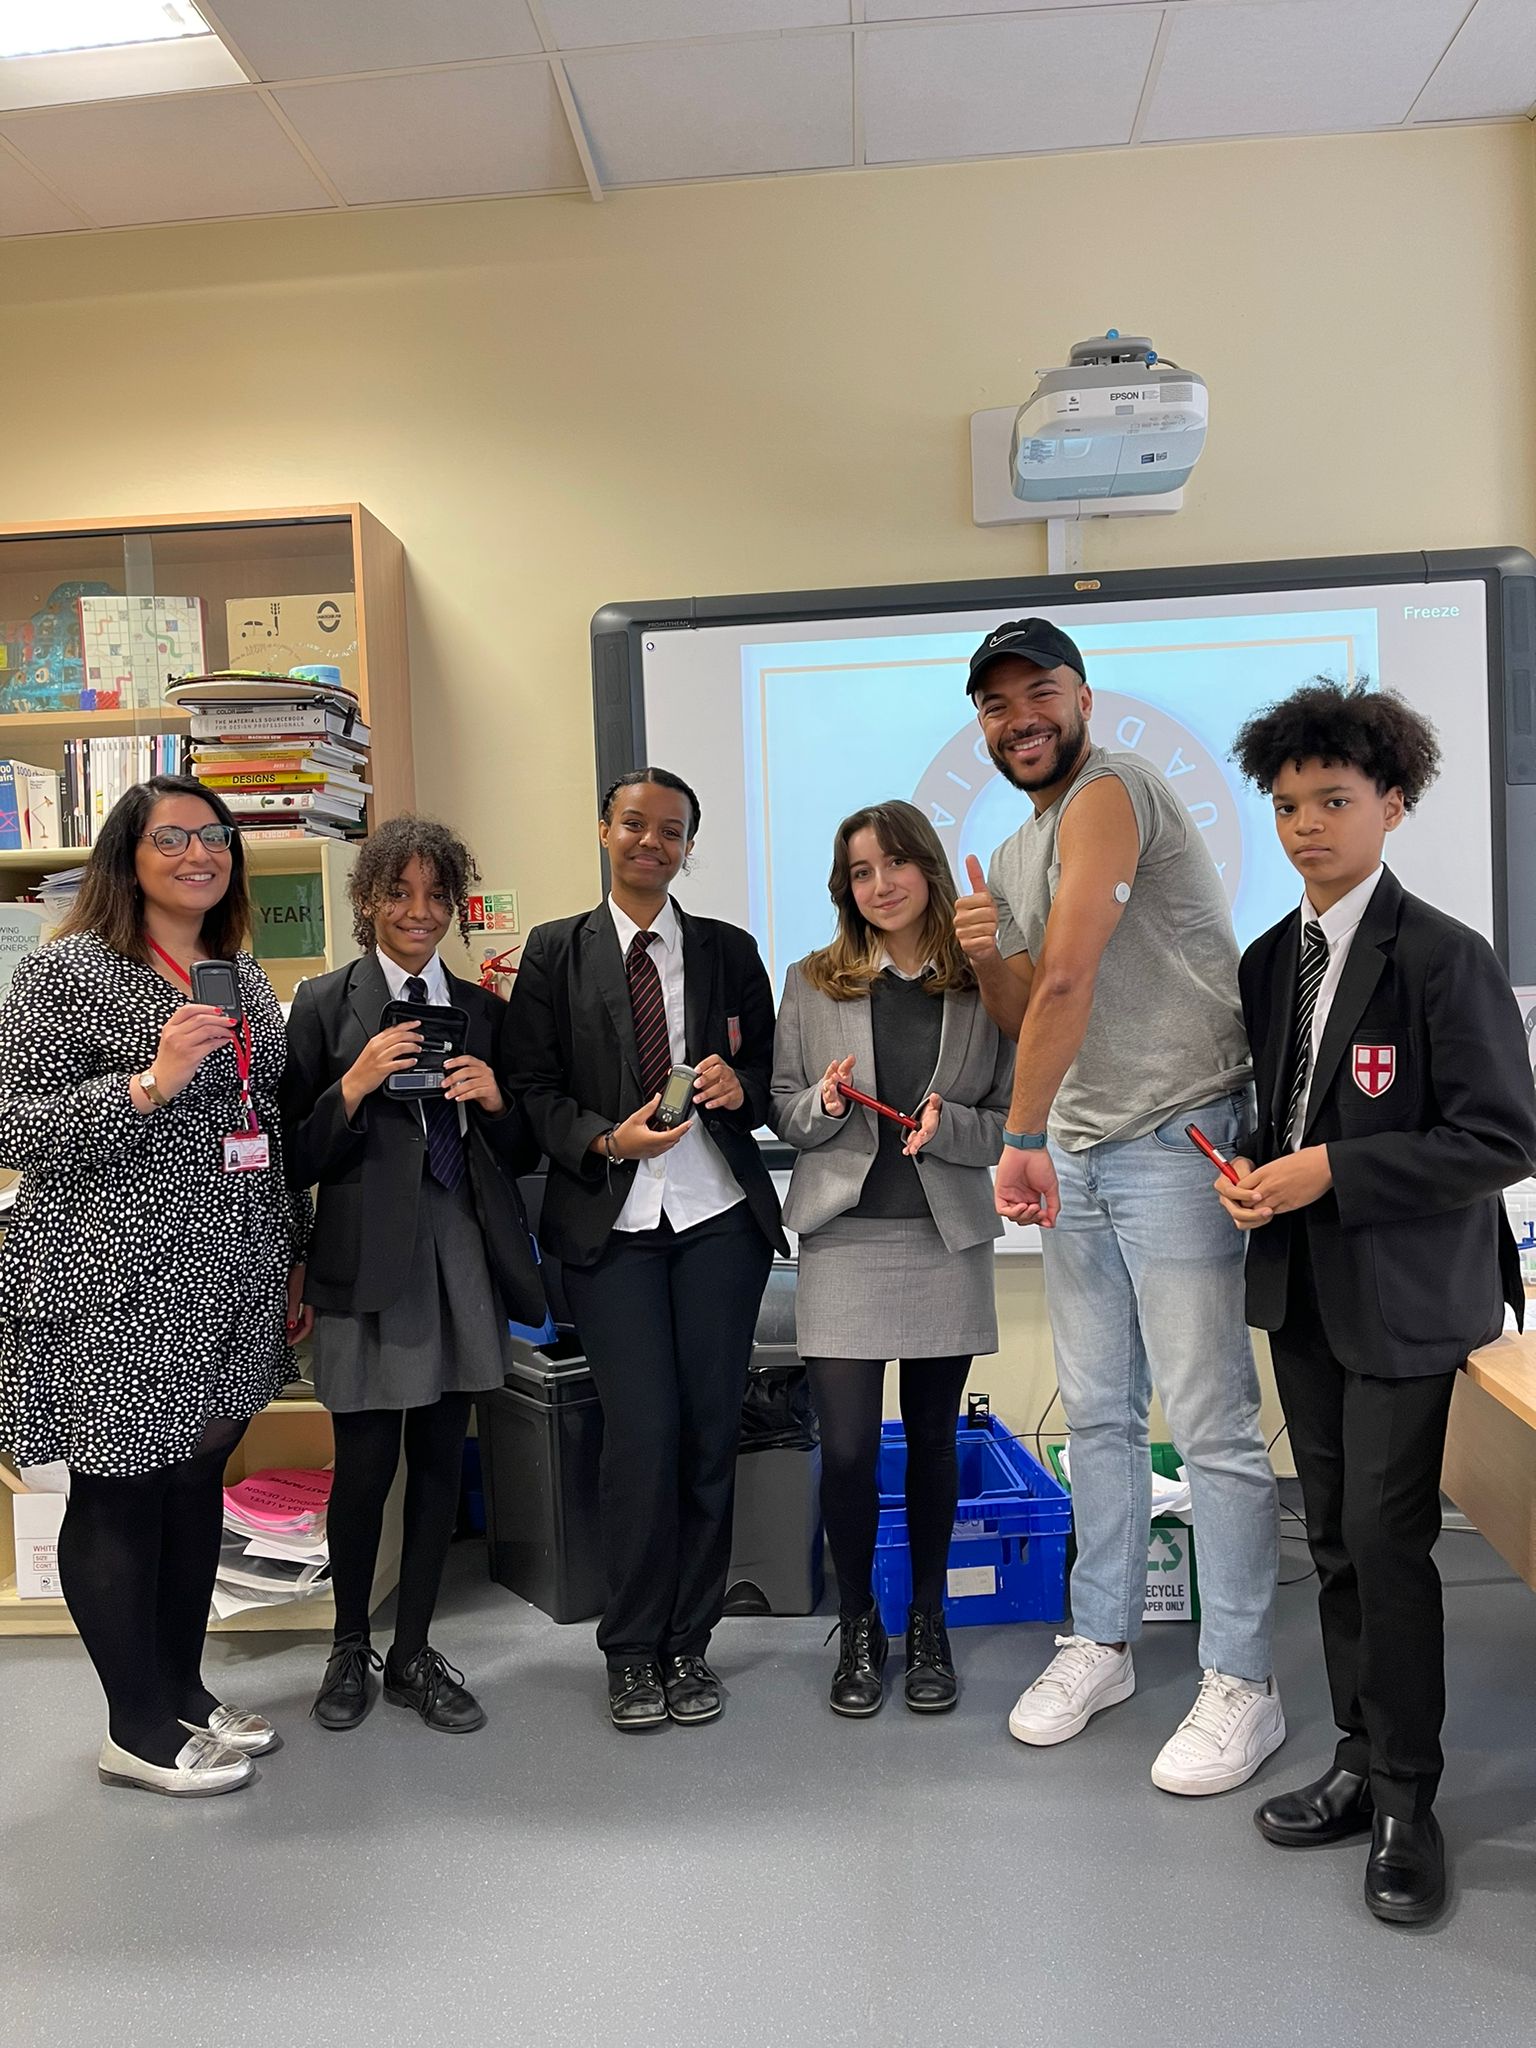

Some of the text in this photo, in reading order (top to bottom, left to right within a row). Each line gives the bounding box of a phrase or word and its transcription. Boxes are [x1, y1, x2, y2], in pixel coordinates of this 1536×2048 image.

[1110, 392, 1139, 401] EPSON
[1404, 606, 1460, 620] Freeze
[264, 715, 305, 723] SOURCEBOOK
[232, 774, 276, 785] DESIGNS
[260, 905, 312, 924] YEAR
[1, 935, 40, 943] PRODUCT
[244, 1486, 280, 1500] DESIGN
[1145, 1584, 1185, 1597] ECYCLE
[1143, 1600, 1184, 1611] APER ONLY
